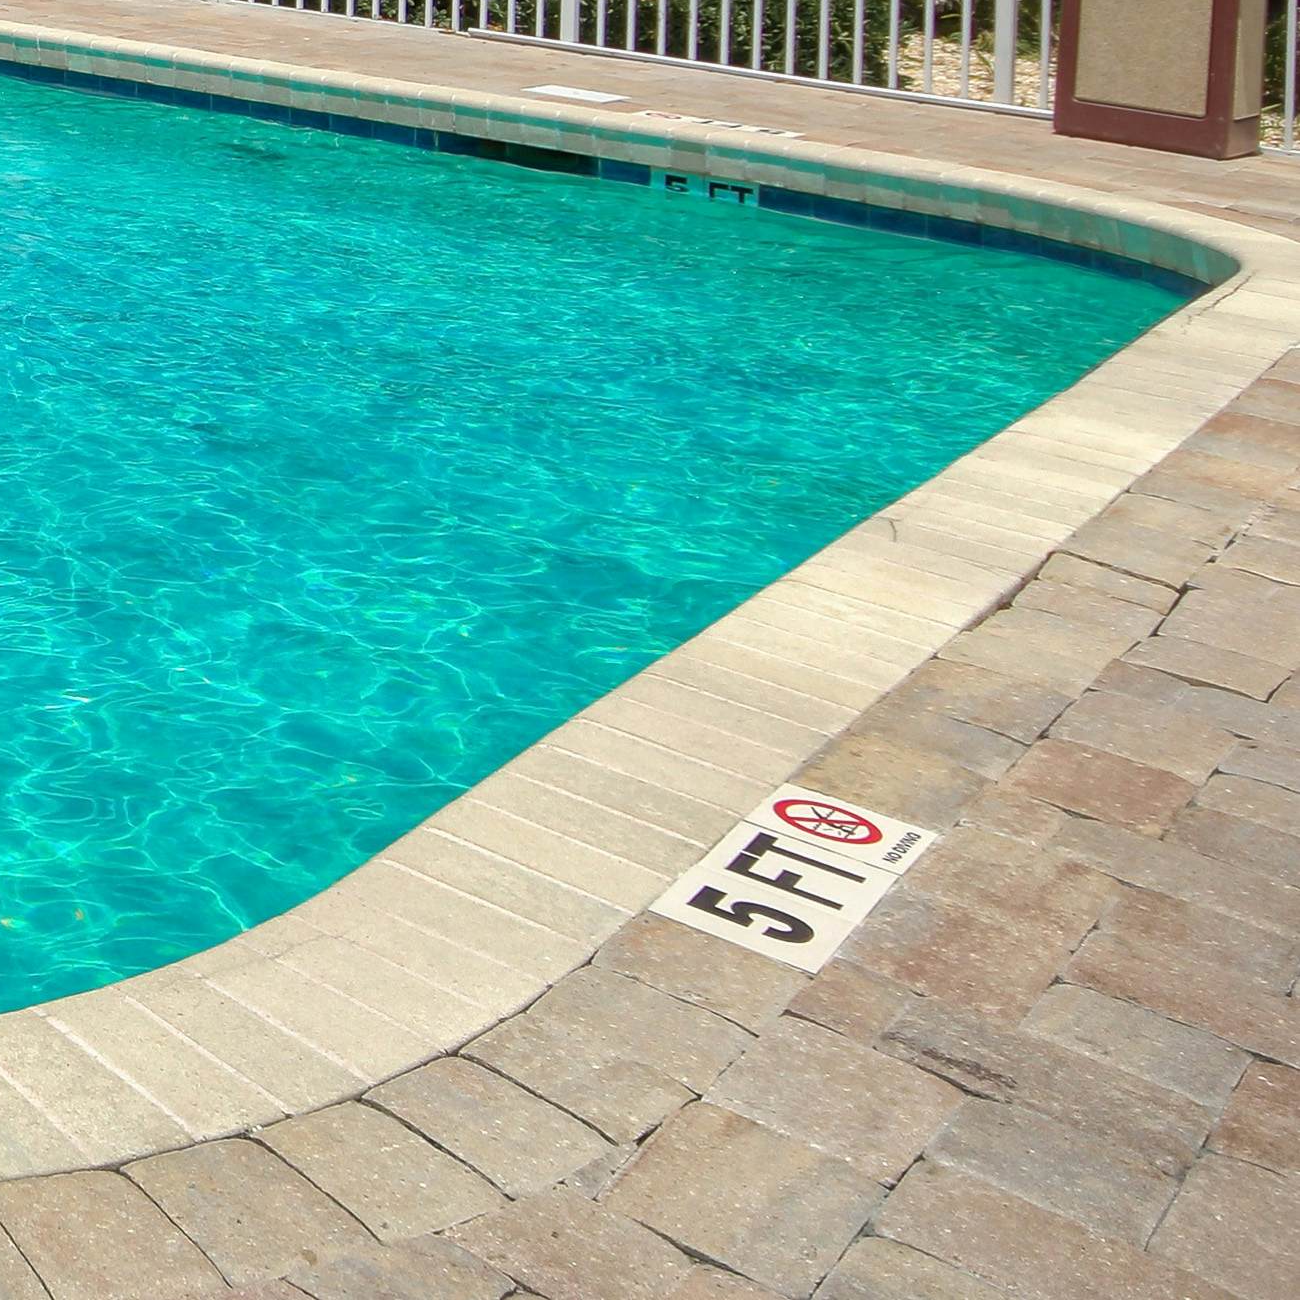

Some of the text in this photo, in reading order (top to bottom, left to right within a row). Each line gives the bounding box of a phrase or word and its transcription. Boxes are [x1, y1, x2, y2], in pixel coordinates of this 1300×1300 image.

[882, 831, 922, 865] NO DIVING
[686, 831, 867, 944] 5 FT
